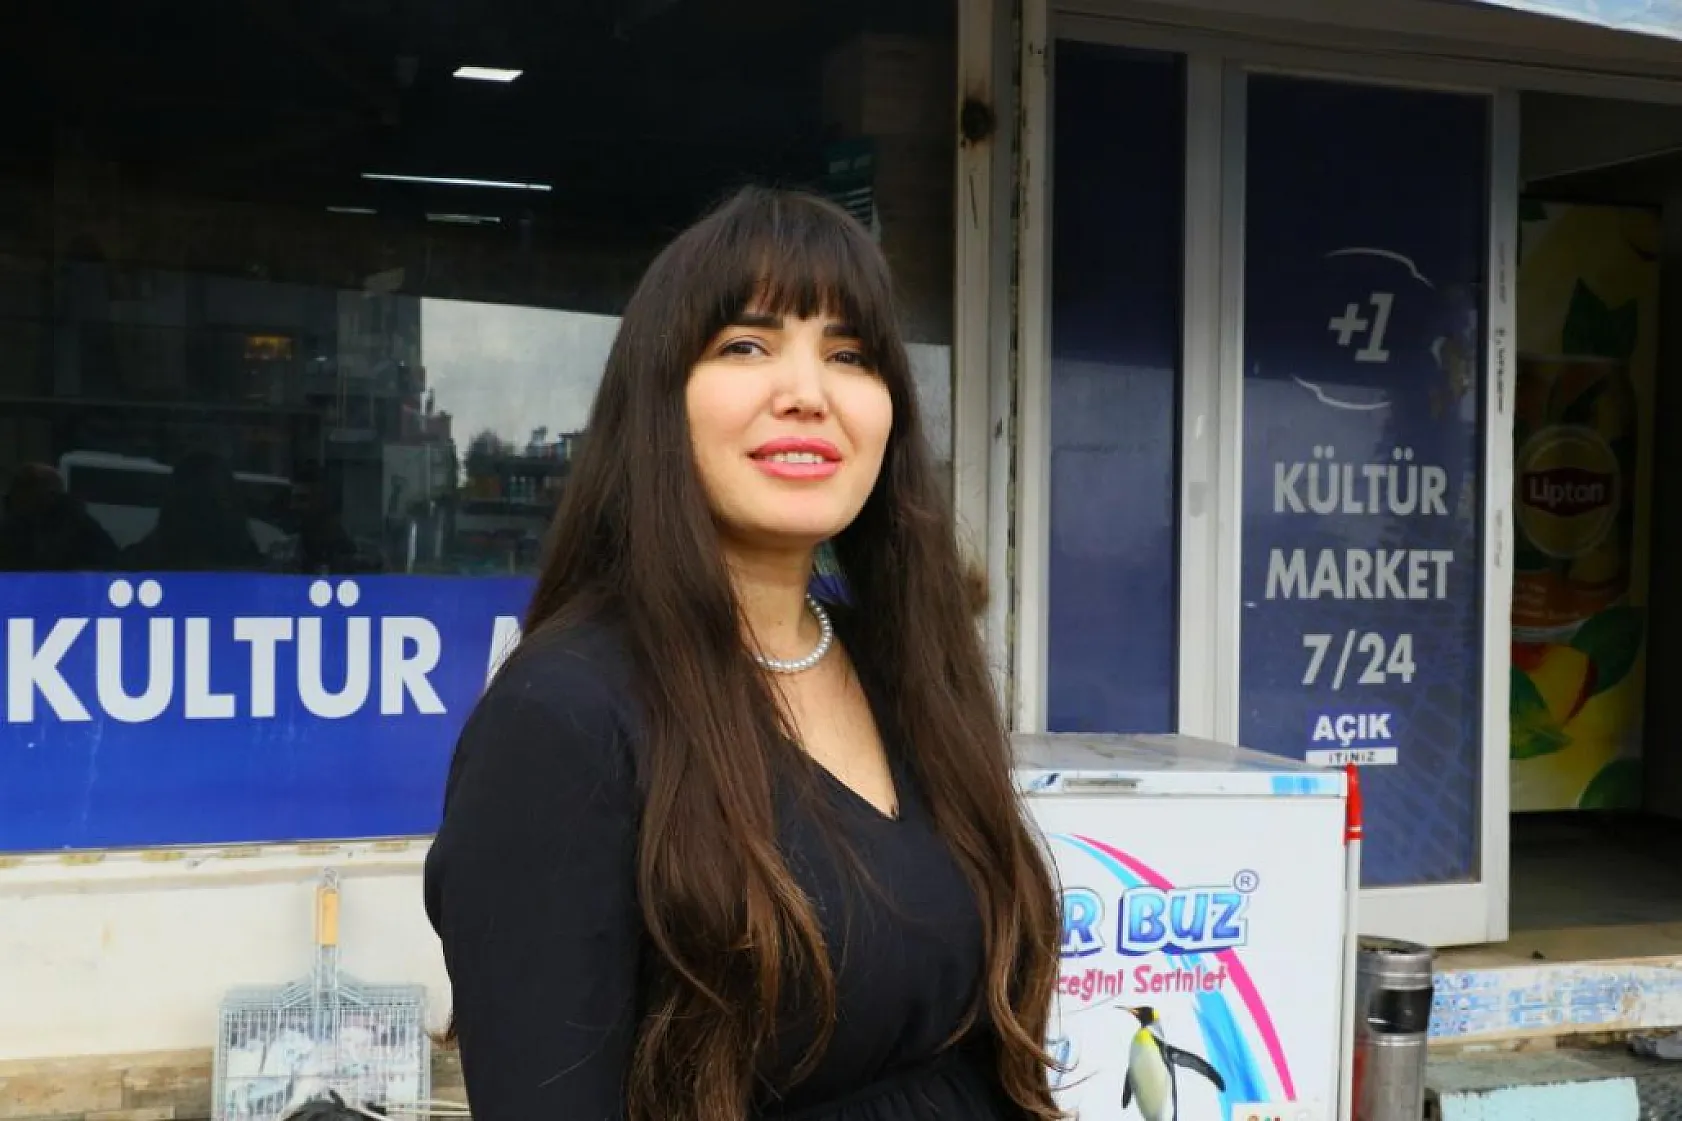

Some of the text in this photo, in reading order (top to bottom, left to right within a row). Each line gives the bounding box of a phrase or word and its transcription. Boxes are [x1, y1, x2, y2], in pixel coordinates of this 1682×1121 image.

[1327, 293, 1395, 363] +1
[1273, 445, 1449, 516] KÜLTÜR
[1529, 476, 1605, 510] Lipton
[1265, 548, 1454, 600] MARKET
[7, 579, 448, 724] KÜLTÜR
[1301, 629, 1417, 690] 7/24
[1312, 713, 1392, 747] AÇIK
[1124, 890, 1245, 948] BUZ
[1133, 964, 1227, 993] Serinlet
